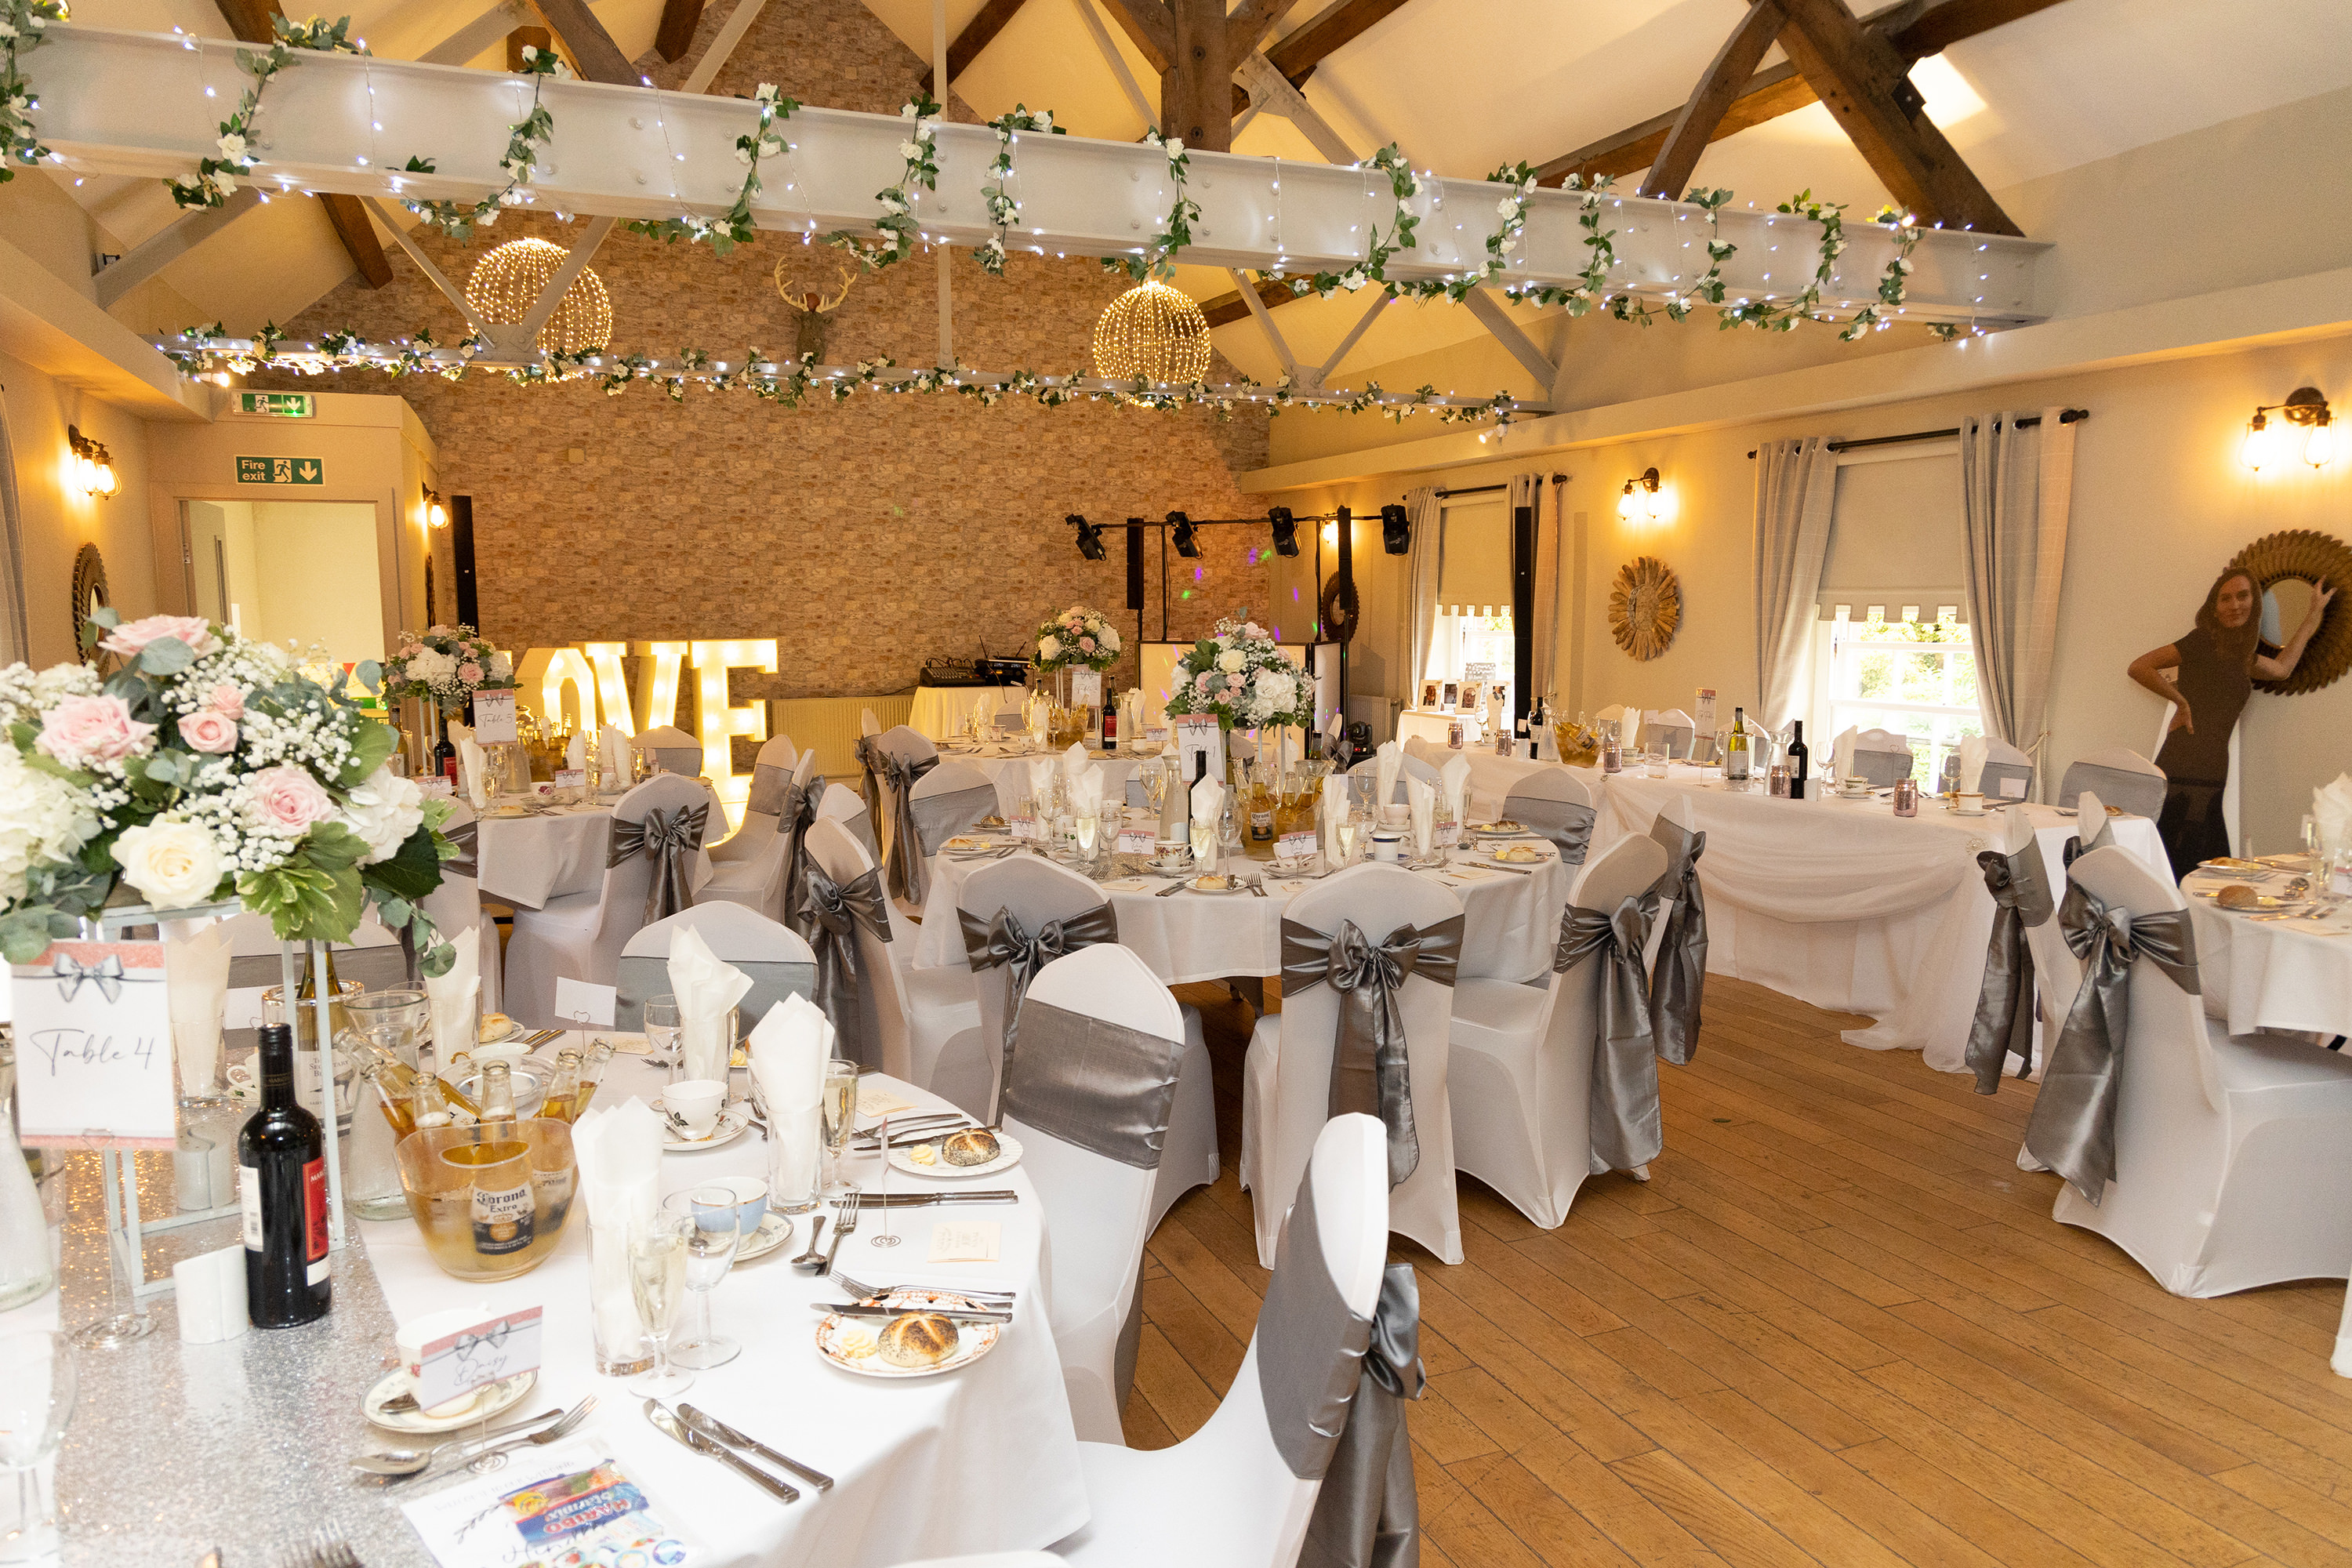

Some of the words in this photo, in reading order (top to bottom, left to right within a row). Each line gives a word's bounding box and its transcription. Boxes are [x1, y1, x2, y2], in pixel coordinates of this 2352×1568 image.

[241, 459, 266, 470] Fire
[241, 471, 266, 481] exit
[504, 639, 779, 806] OVE
[29, 1027, 125, 1076] Table
[134, 1036, 154, 1069] 4
[309, 1059, 349, 1070] SECTARY
[477, 1189, 527, 1206] Corona
[490, 1204, 517, 1213] Extra
[543, 1497, 633, 1534] HARIBO
